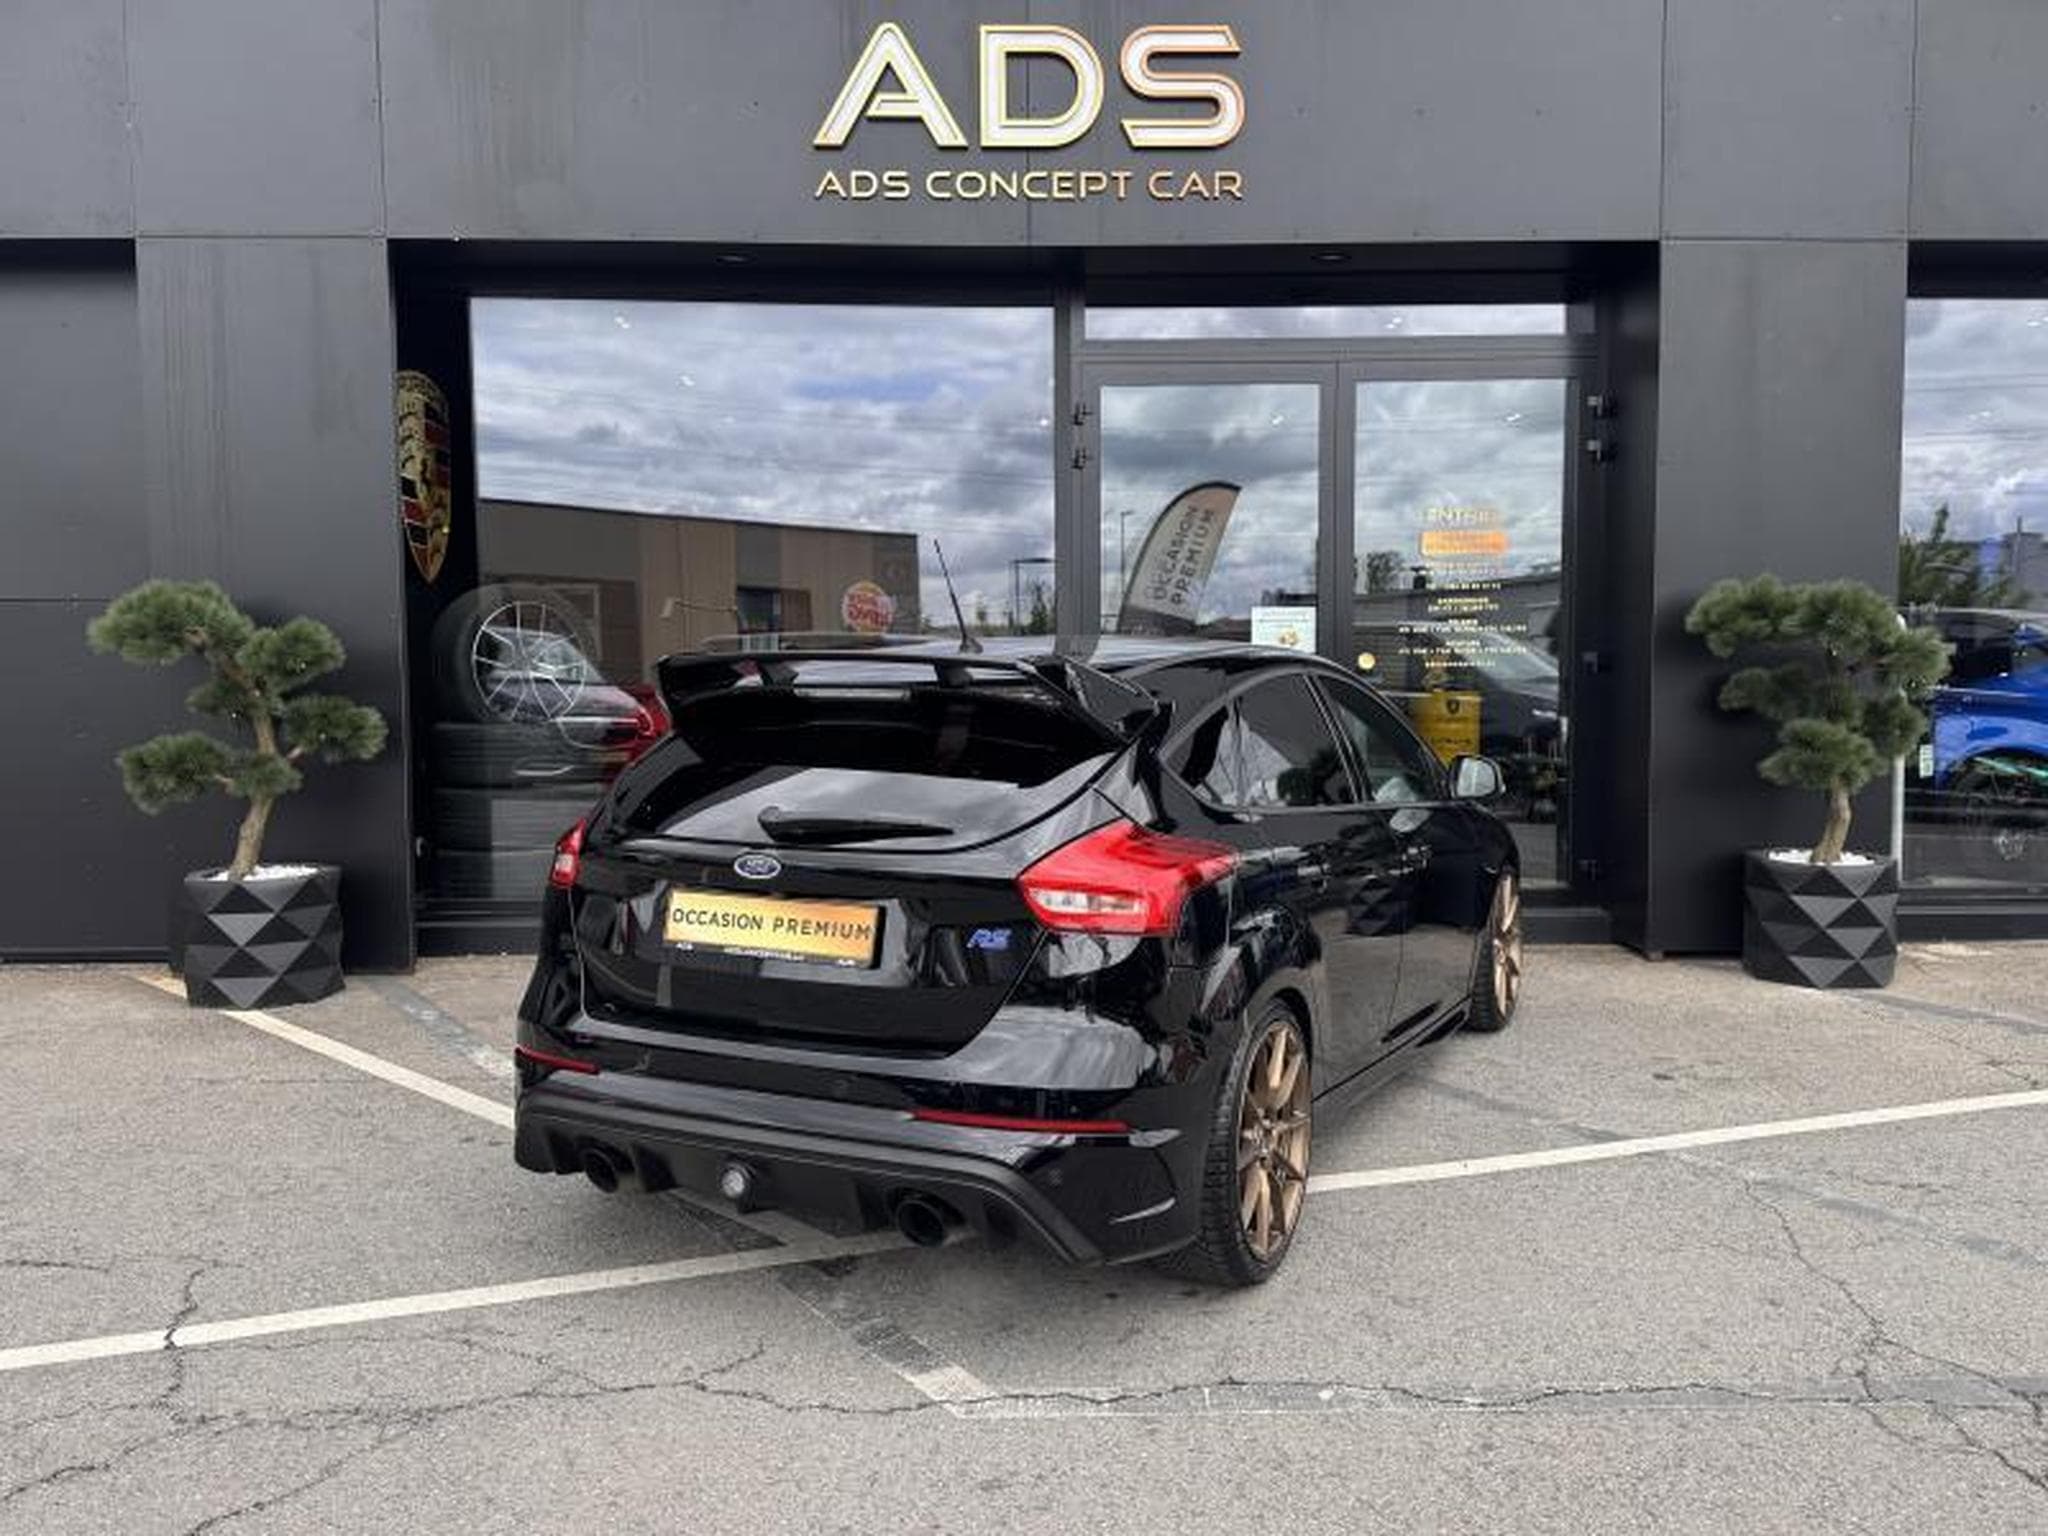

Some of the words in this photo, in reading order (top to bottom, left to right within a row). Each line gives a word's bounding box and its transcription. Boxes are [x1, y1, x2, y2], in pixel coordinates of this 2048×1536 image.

[813, 22, 1245, 149] ADS
[815, 171, 911, 199] ADS
[926, 171, 1135, 199] CONCEPT
[1148, 171, 1244, 199] CAR
[1170, 508, 1215, 606] PREMIUM
[672, 907, 764, 931] OCCASION
[773, 918, 872, 941] PREMIUM
